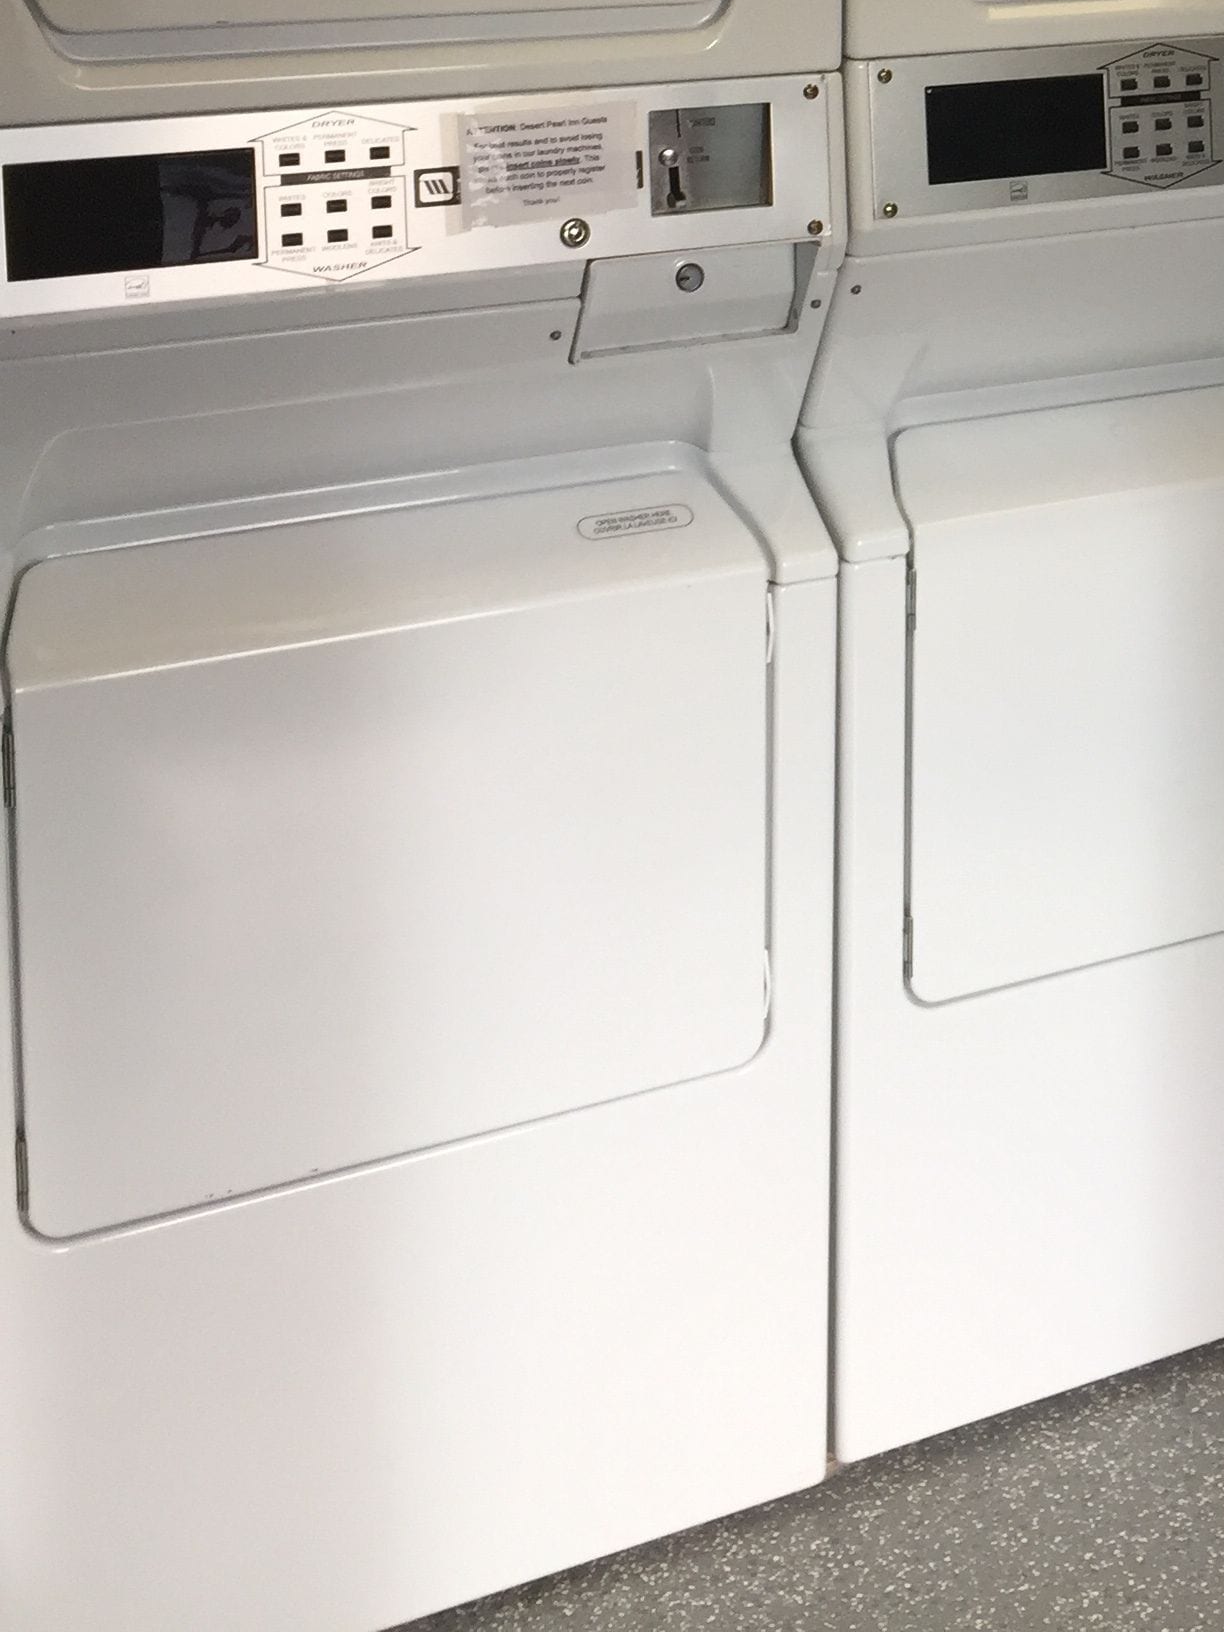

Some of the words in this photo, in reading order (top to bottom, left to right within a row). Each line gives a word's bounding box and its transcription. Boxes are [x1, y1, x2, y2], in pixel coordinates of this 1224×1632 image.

[311, 119, 356, 128] DRYER
[519, 122, 545, 131] Desert
[312, 262, 368, 273] WASHER
